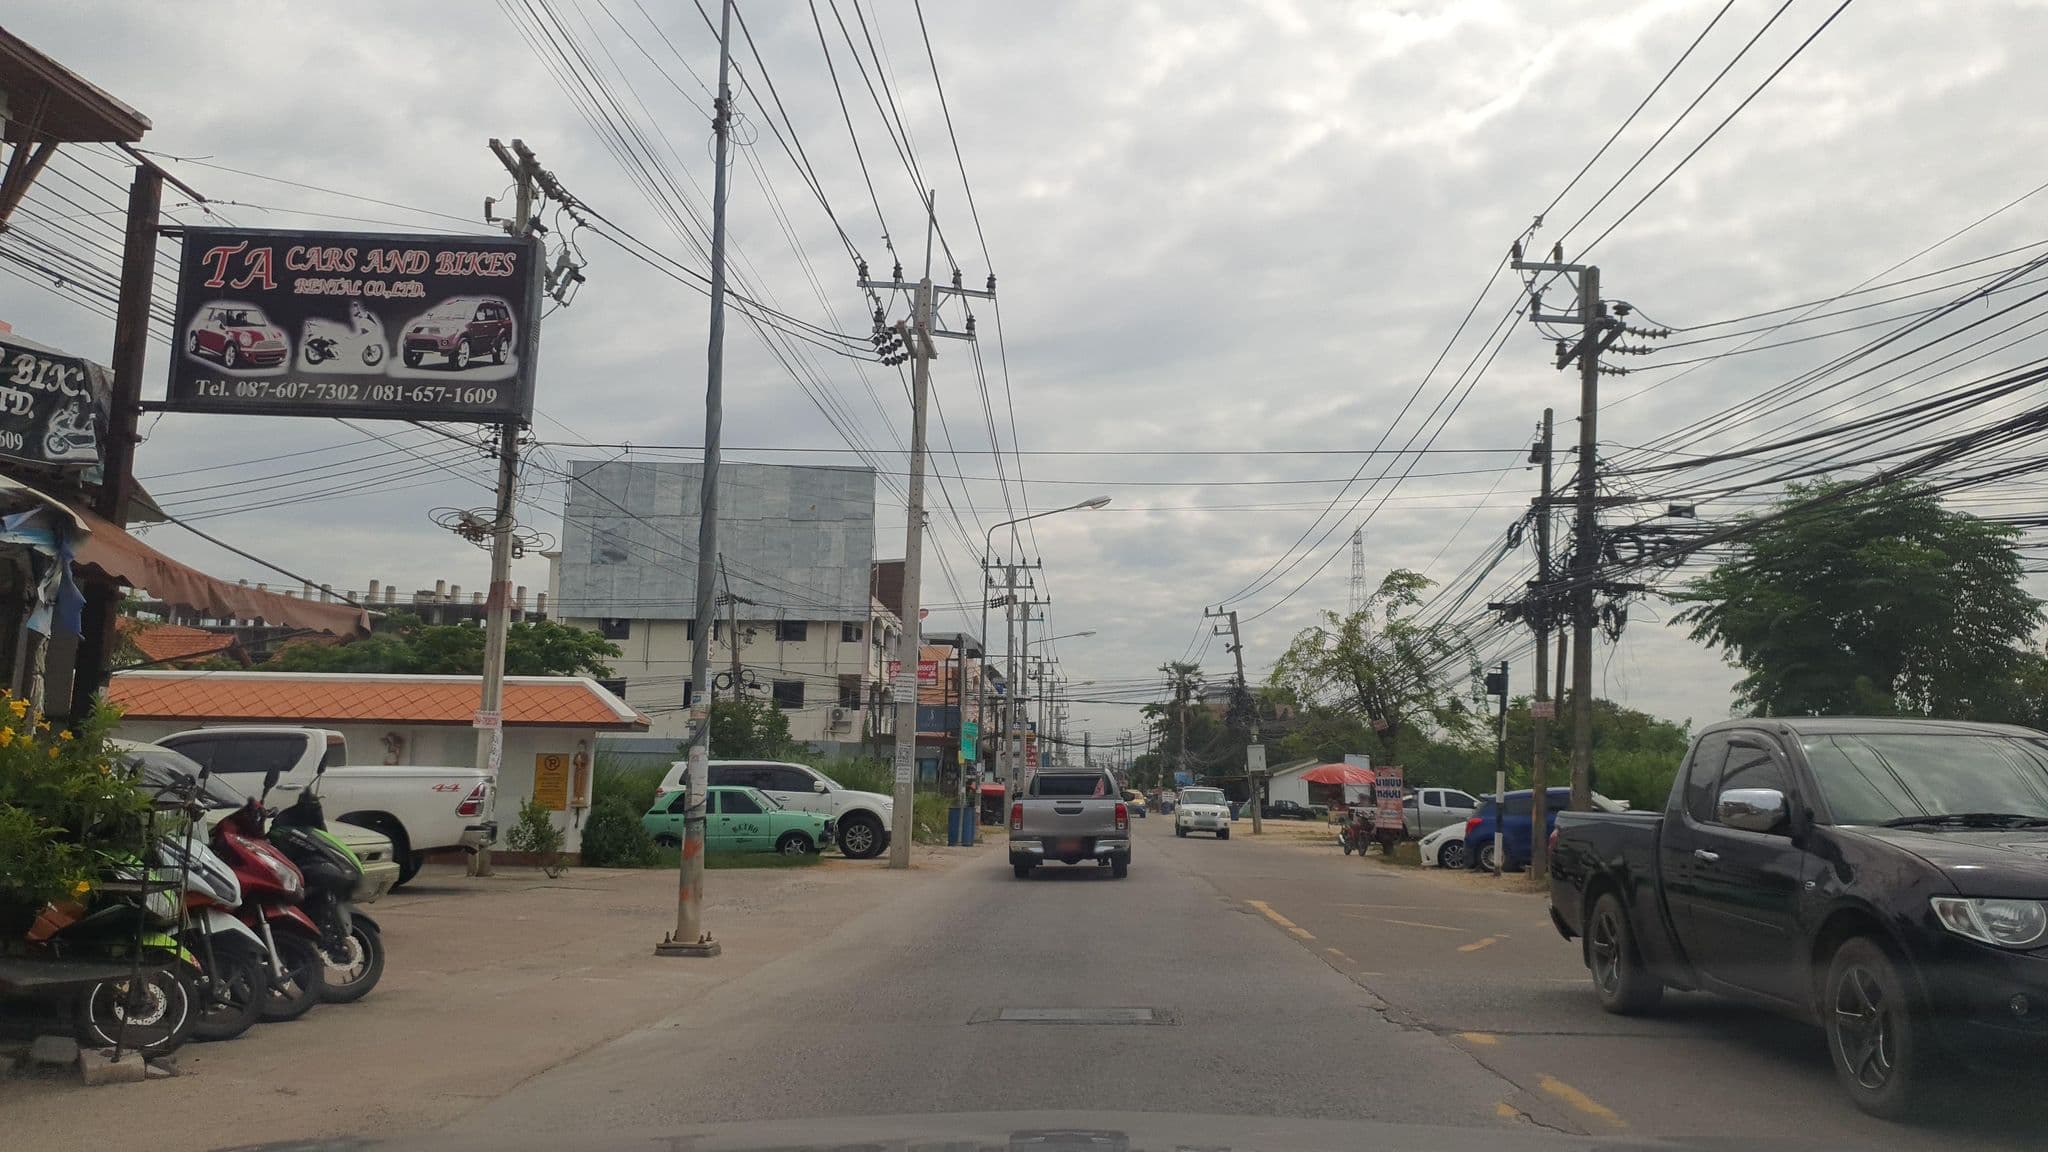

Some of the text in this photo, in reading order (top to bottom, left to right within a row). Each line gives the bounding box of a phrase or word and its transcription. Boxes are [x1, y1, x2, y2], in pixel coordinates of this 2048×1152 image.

[285, 246, 358, 274] CARS
[360, 249, 430, 275] AND
[434, 251, 517, 277] BIKES
[293, 277, 362, 296] RENTAL
[195, 379, 230, 397] Tel.
[236, 381, 359, 400] 087-607-7302
